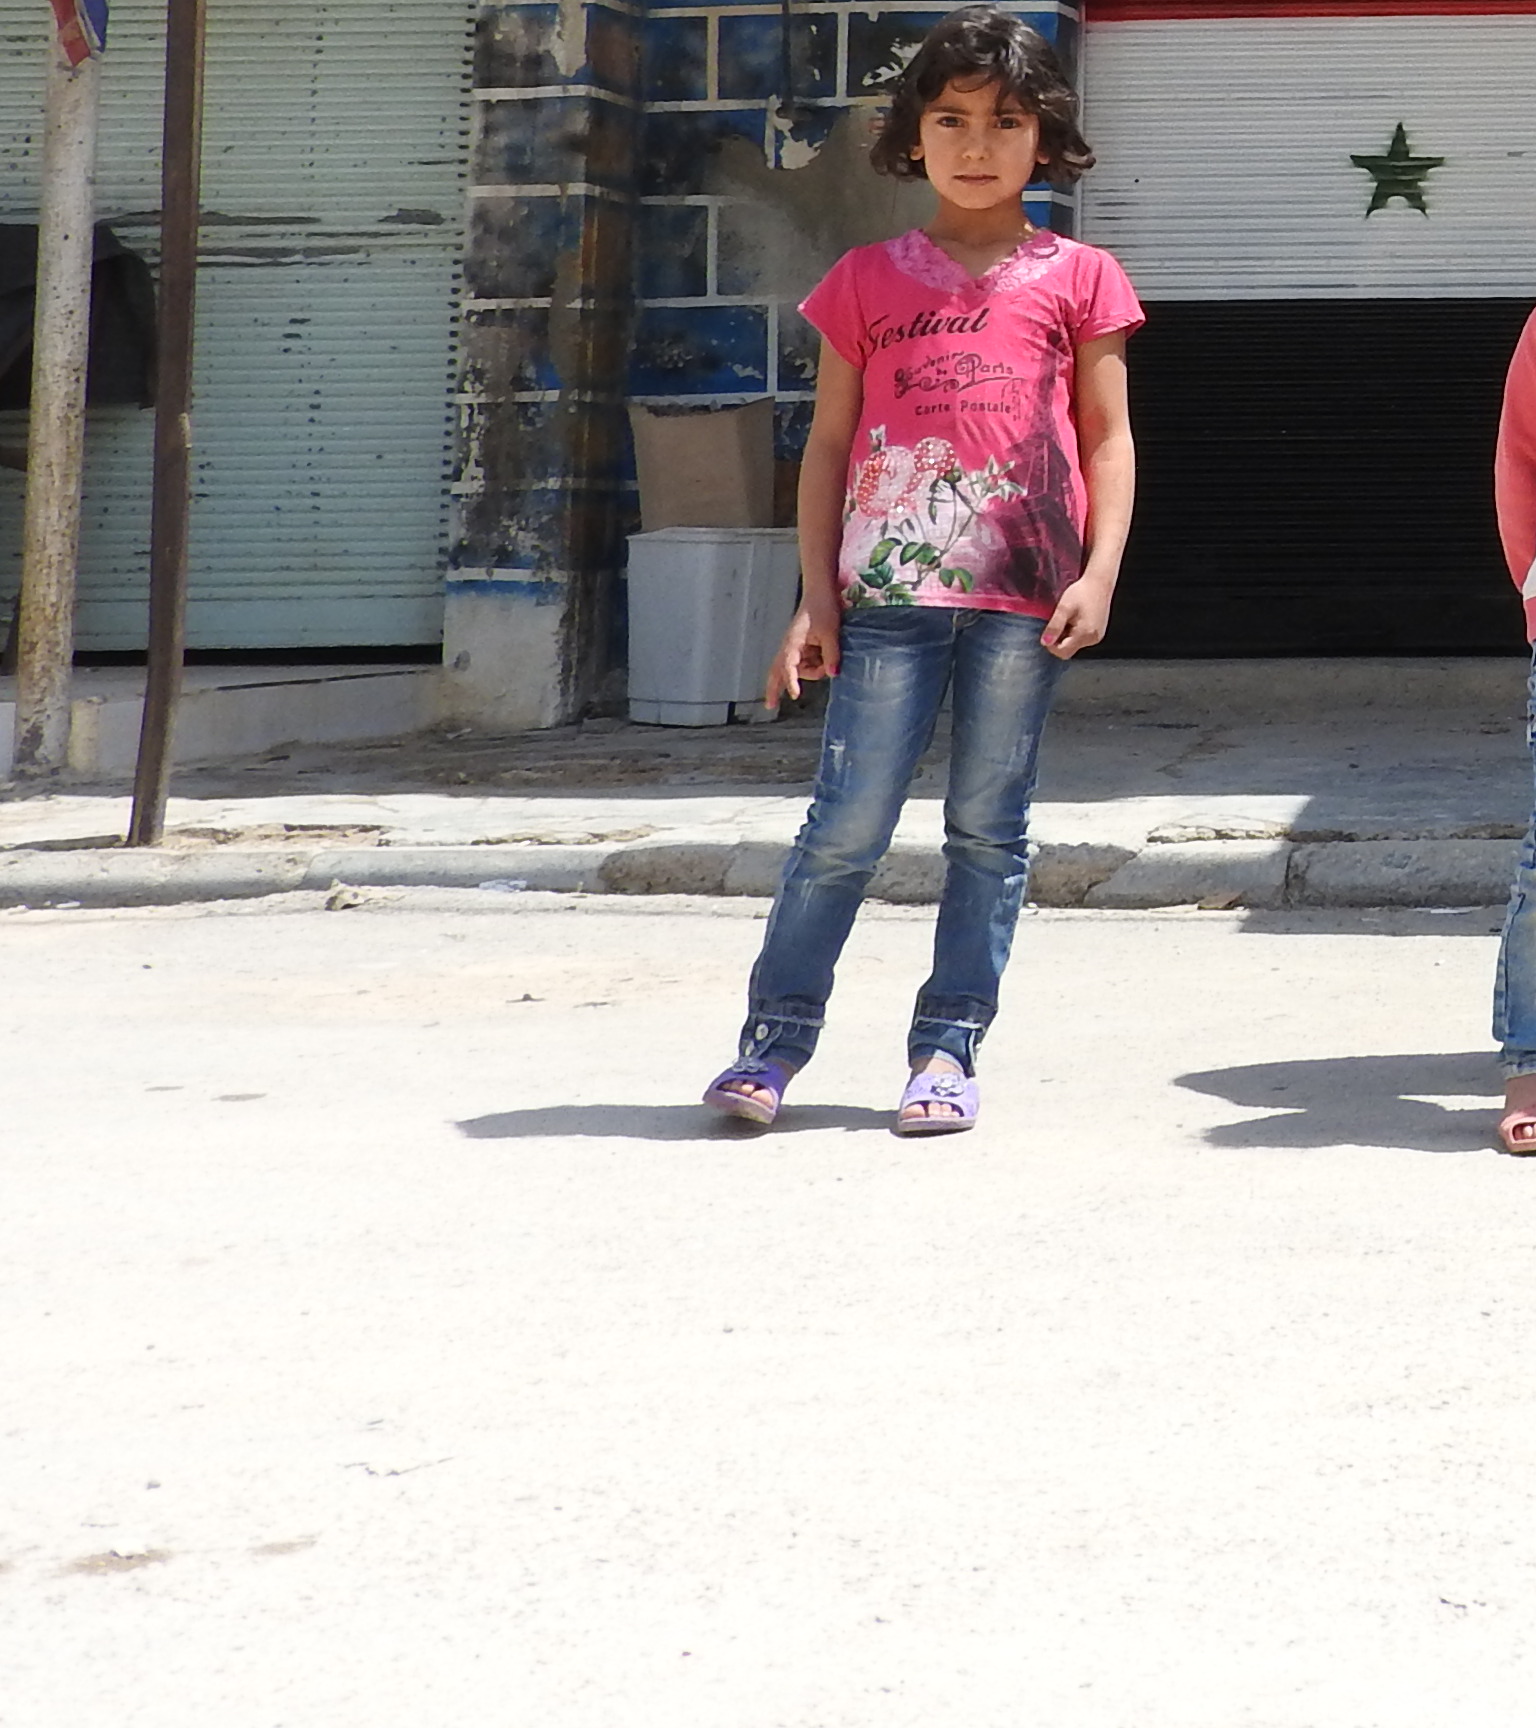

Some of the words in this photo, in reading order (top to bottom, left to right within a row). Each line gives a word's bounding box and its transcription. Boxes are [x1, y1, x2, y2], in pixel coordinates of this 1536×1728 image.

[868, 308, 989, 358] Festival
[915, 404, 950, 415] Carte
[960, 400, 1012, 414] Postale
